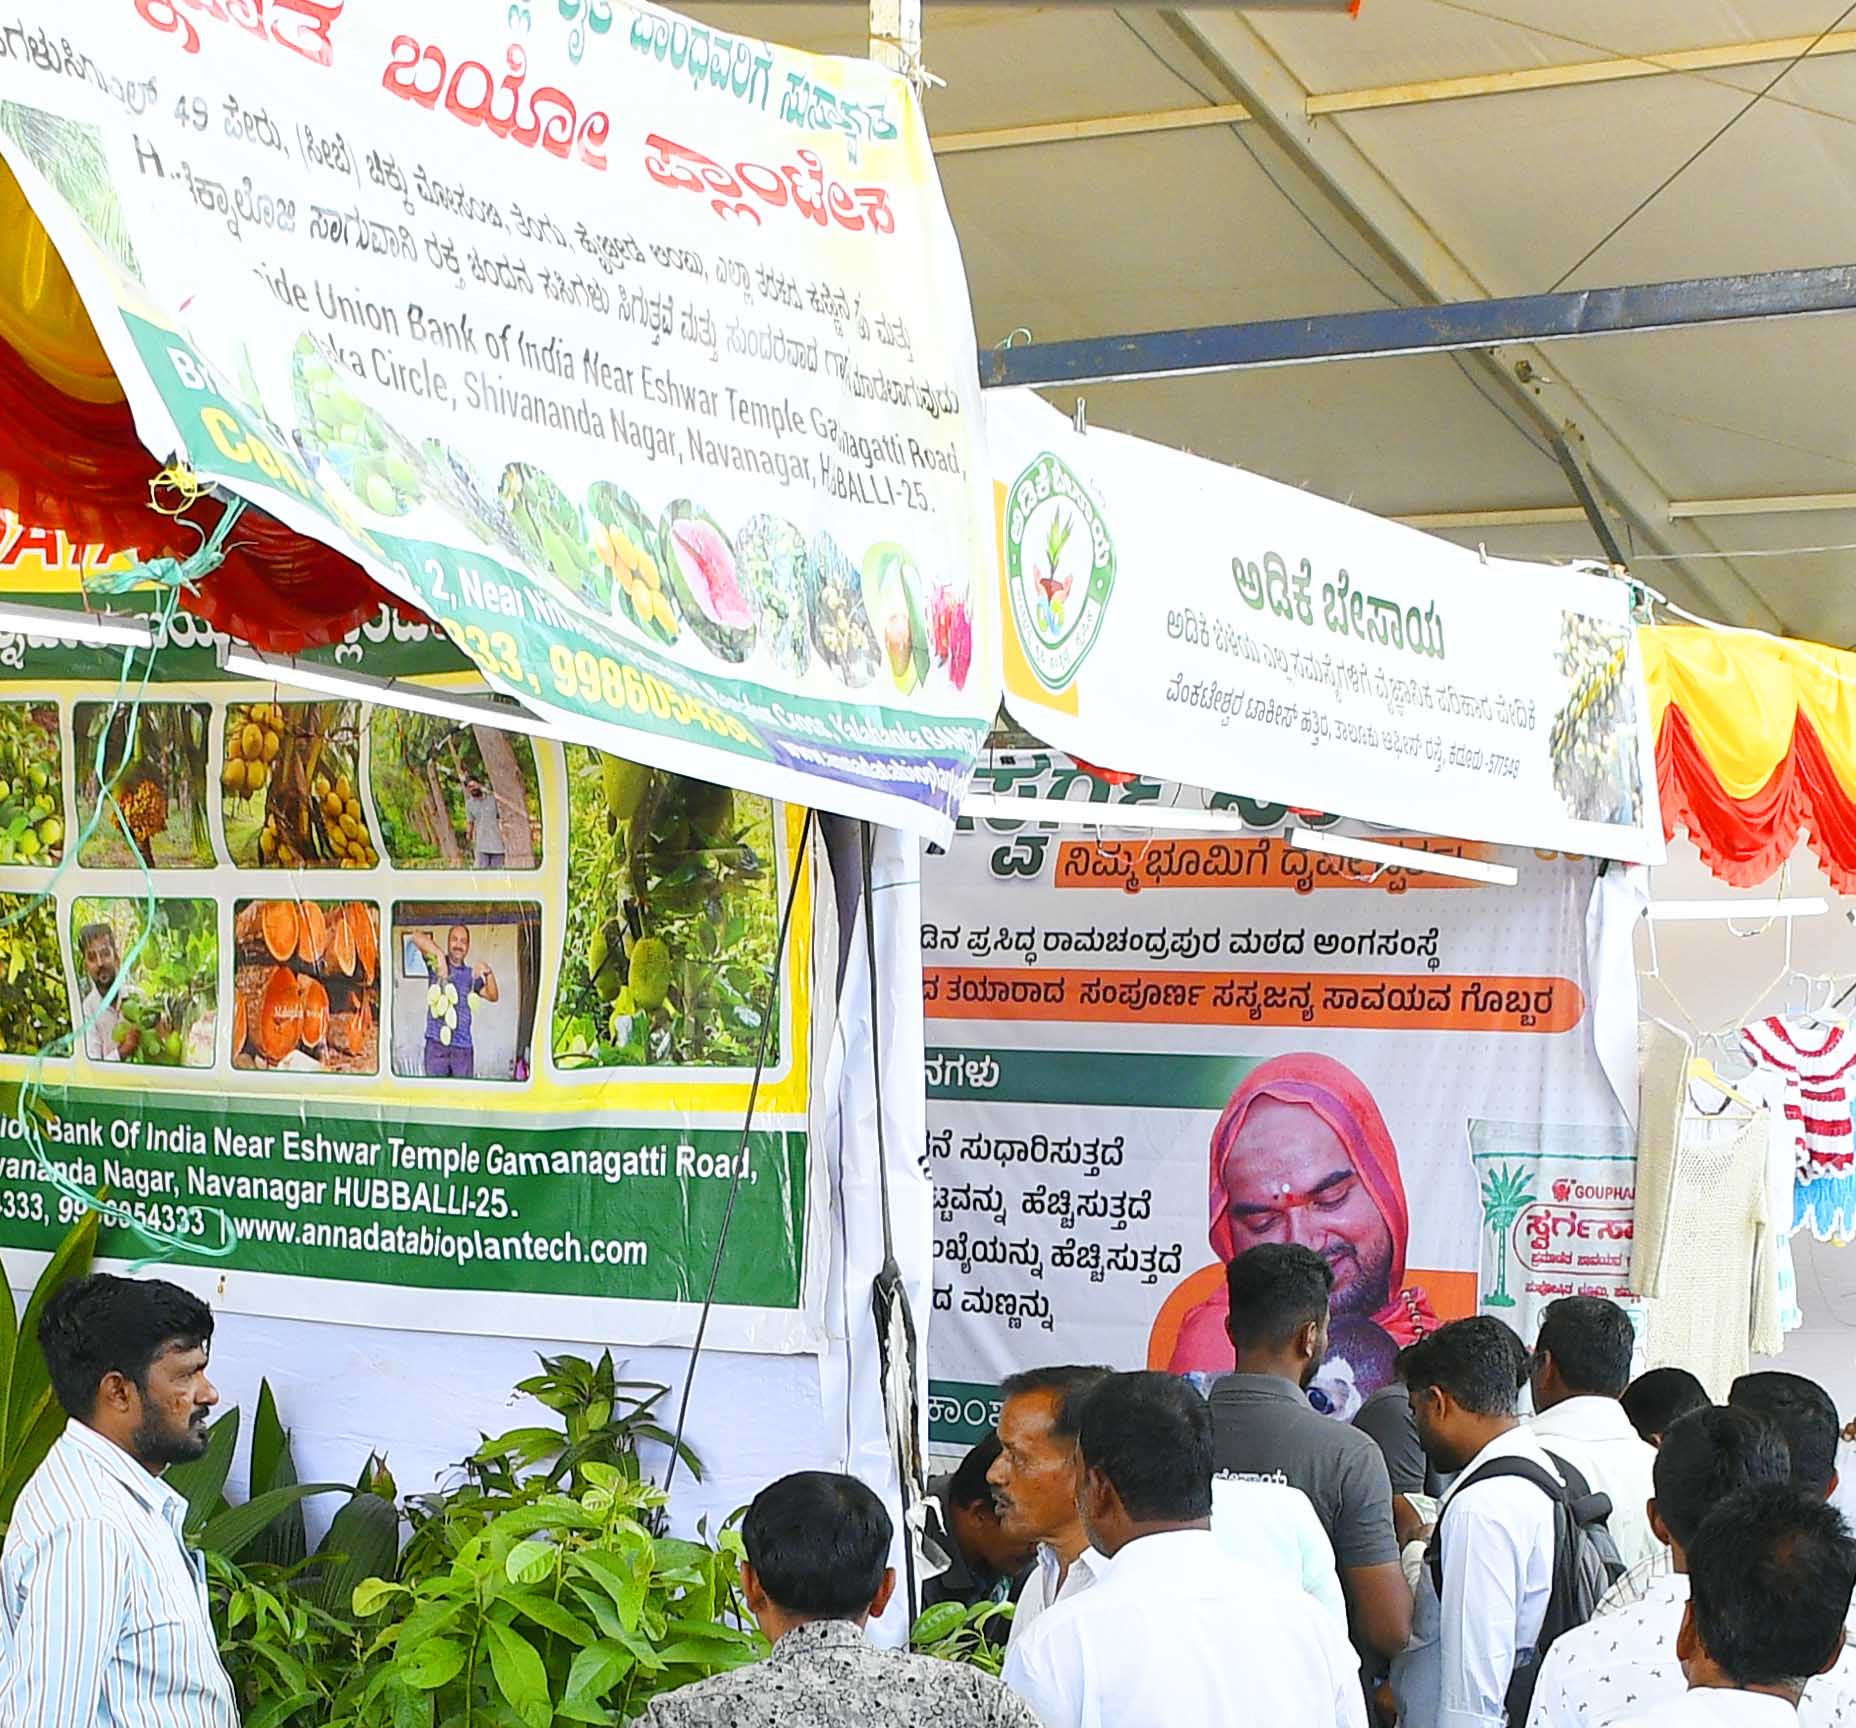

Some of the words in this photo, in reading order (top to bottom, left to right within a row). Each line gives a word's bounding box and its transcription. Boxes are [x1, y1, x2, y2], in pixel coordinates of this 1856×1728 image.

[175, 95, 208, 131] 49
[382, 33, 610, 170] ಬಯೋ
[315, 281, 399, 337] Union
[408, 304, 476, 355] Bank
[486, 324, 512, 362] of
[519, 330, 575, 383] India
[583, 348, 634, 397] Near
[642, 367, 718, 418] Eshwar
[726, 387, 804, 442] Temple
[912, 437, 967, 481] Road,
[372, 347, 457, 411] Circle,
[464, 370, 605, 439] Shivananda
[610, 407, 683, 464] Nagar,
[688, 430, 816, 489] Navanagar,
[1231, 551, 1314, 627] ಅಡಿಕೆ
[1322, 569, 1445, 660] ಬೇಸಾಯ
[1145, 838, 1270, 883] ಭೂಮಿಗೆ
[921, 924, 960, 951] ಡಿನ
[967, 925, 1036, 965] ಪ್ರಸಿದ್ಧ
[1044, 927, 1220, 959] ರಾಮಚಂದ್ರಪುರ
[1229, 928, 1304, 955] ಮಠದ
[1314, 928, 1440, 970] ಅಂಗಸಂಸ್ಥೆ
[947, 976, 1065, 1003] ತಯಾರಾದ
[1080, 977, 1205, 1009] ಸಂಪೂರ್ಣ
[1212, 980, 1314, 1021] ಸಸ್ಯಜನ್ಯ
[1323, 981, 1452, 1011] ಸಾವಯವ
[1460, 981, 1553, 1026] ಗೊಬ್ಬರ
[926, 1053, 1000, 1088] ನಗಳು
[46, 1115, 104, 1147] Bank
[110, 1119, 142, 1150] Of
[146, 1122, 207, 1155] India
[213, 1126, 274, 1160] Near
[282, 1131, 380, 1167] Eshwar
[387, 1138, 480, 1176] Temple
[485, 1144, 666, 1183] Gamanagatti
[676, 1145, 757, 1185] Road,
[960, 1132, 1125, 1177] ಸುಧಾರಿಸುತ್ತದೆ
[103, 1159, 180, 1197] Nagar,
[187, 1166, 325, 1208] Navanagar
[332, 1176, 519, 1219] HUBBALLI-25.
[932, 1183, 1006, 1227] ಟ್ಟವನ್ನು
[1022, 1184, 1151, 1231] ಹೆಚ್ಚಿಸುತ್ತದೆ
[1575, 1185, 1637, 1201] GOUPHA
[234, 1215, 647, 1266] www.annadatabioplantech.com
[1051, 1238, 1183, 1286] ಹೆಚ್ಚಿಸುತ್ತದೆ
[960, 1285, 1054, 1332] ಮಣ್ಣನ್ನು
